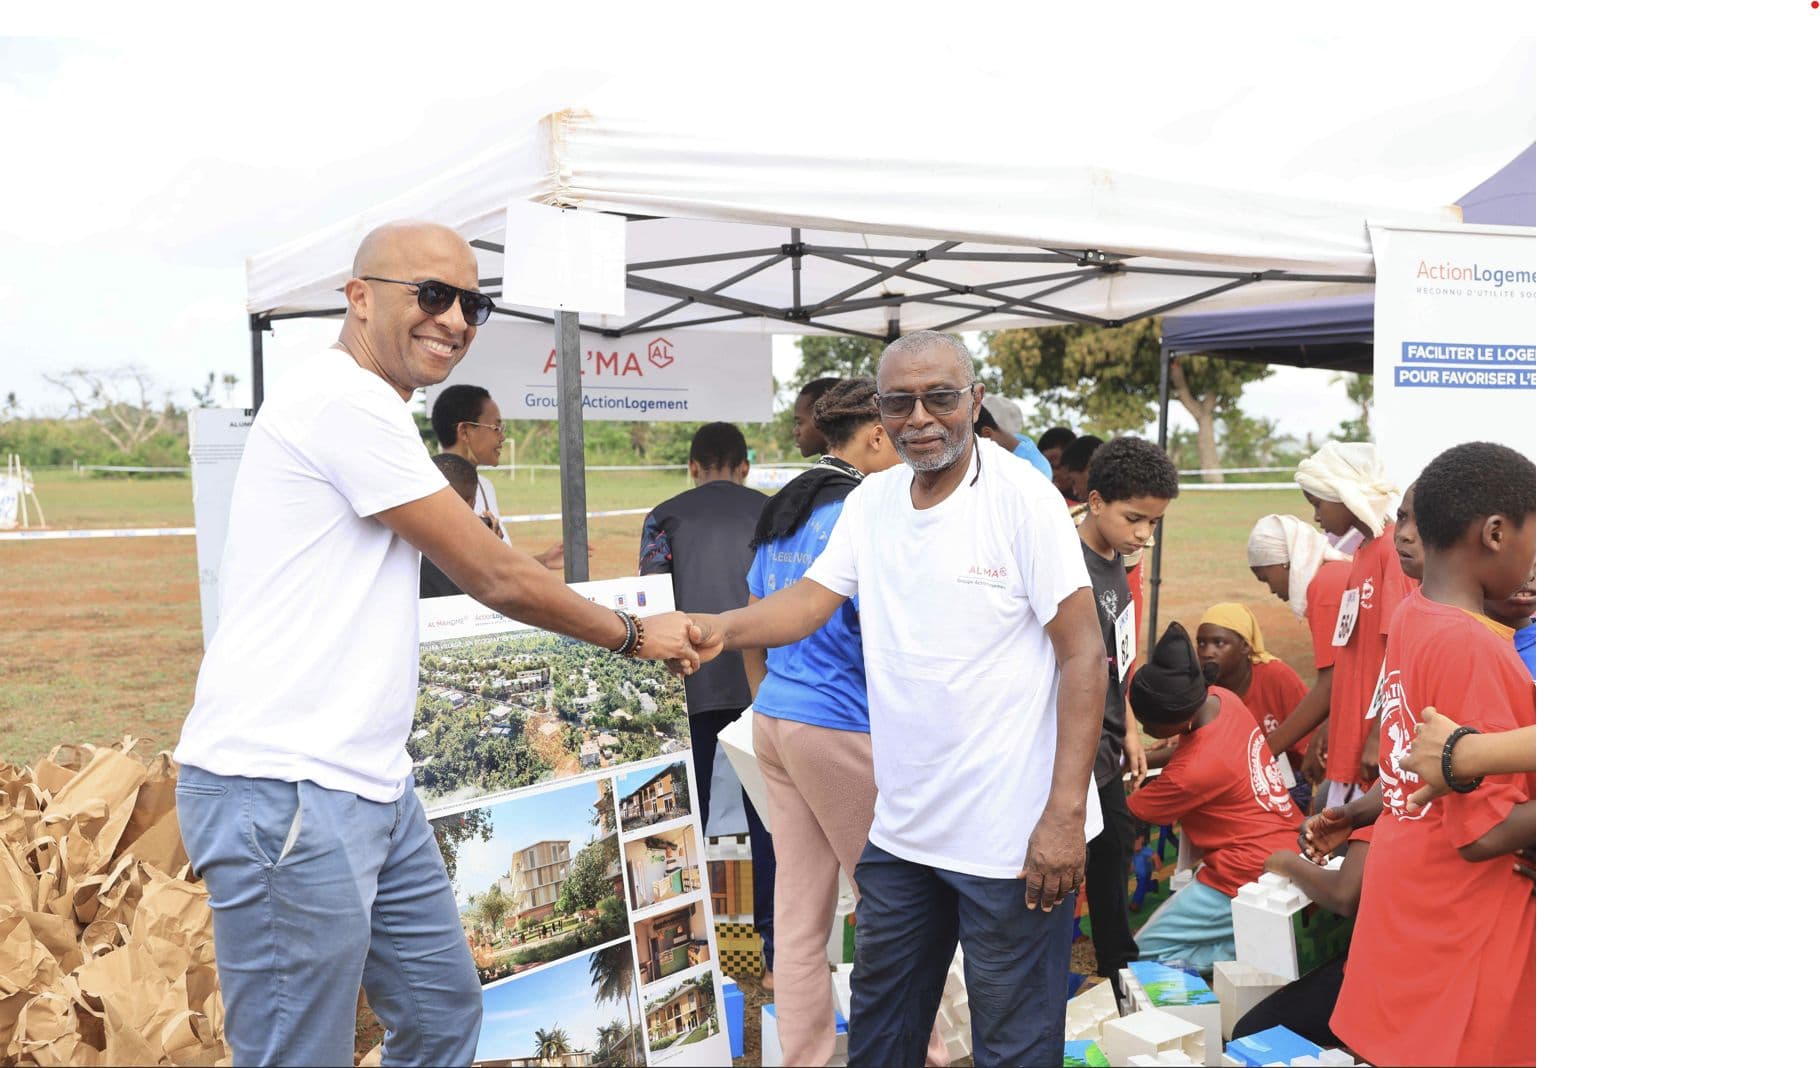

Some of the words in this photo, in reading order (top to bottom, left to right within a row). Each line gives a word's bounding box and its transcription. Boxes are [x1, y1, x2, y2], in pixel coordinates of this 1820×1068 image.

[1407, 345, 1475, 360] FACILITER
[1477, 347, 1494, 361] LE
[543, 349, 643, 376] A'MA
[1400, 370, 1440, 384] POUR
[1442, 371, 1516, 385] FAVORISER
[525, 393, 559, 408] Grou
[581, 394, 688, 410] ActionLogement
